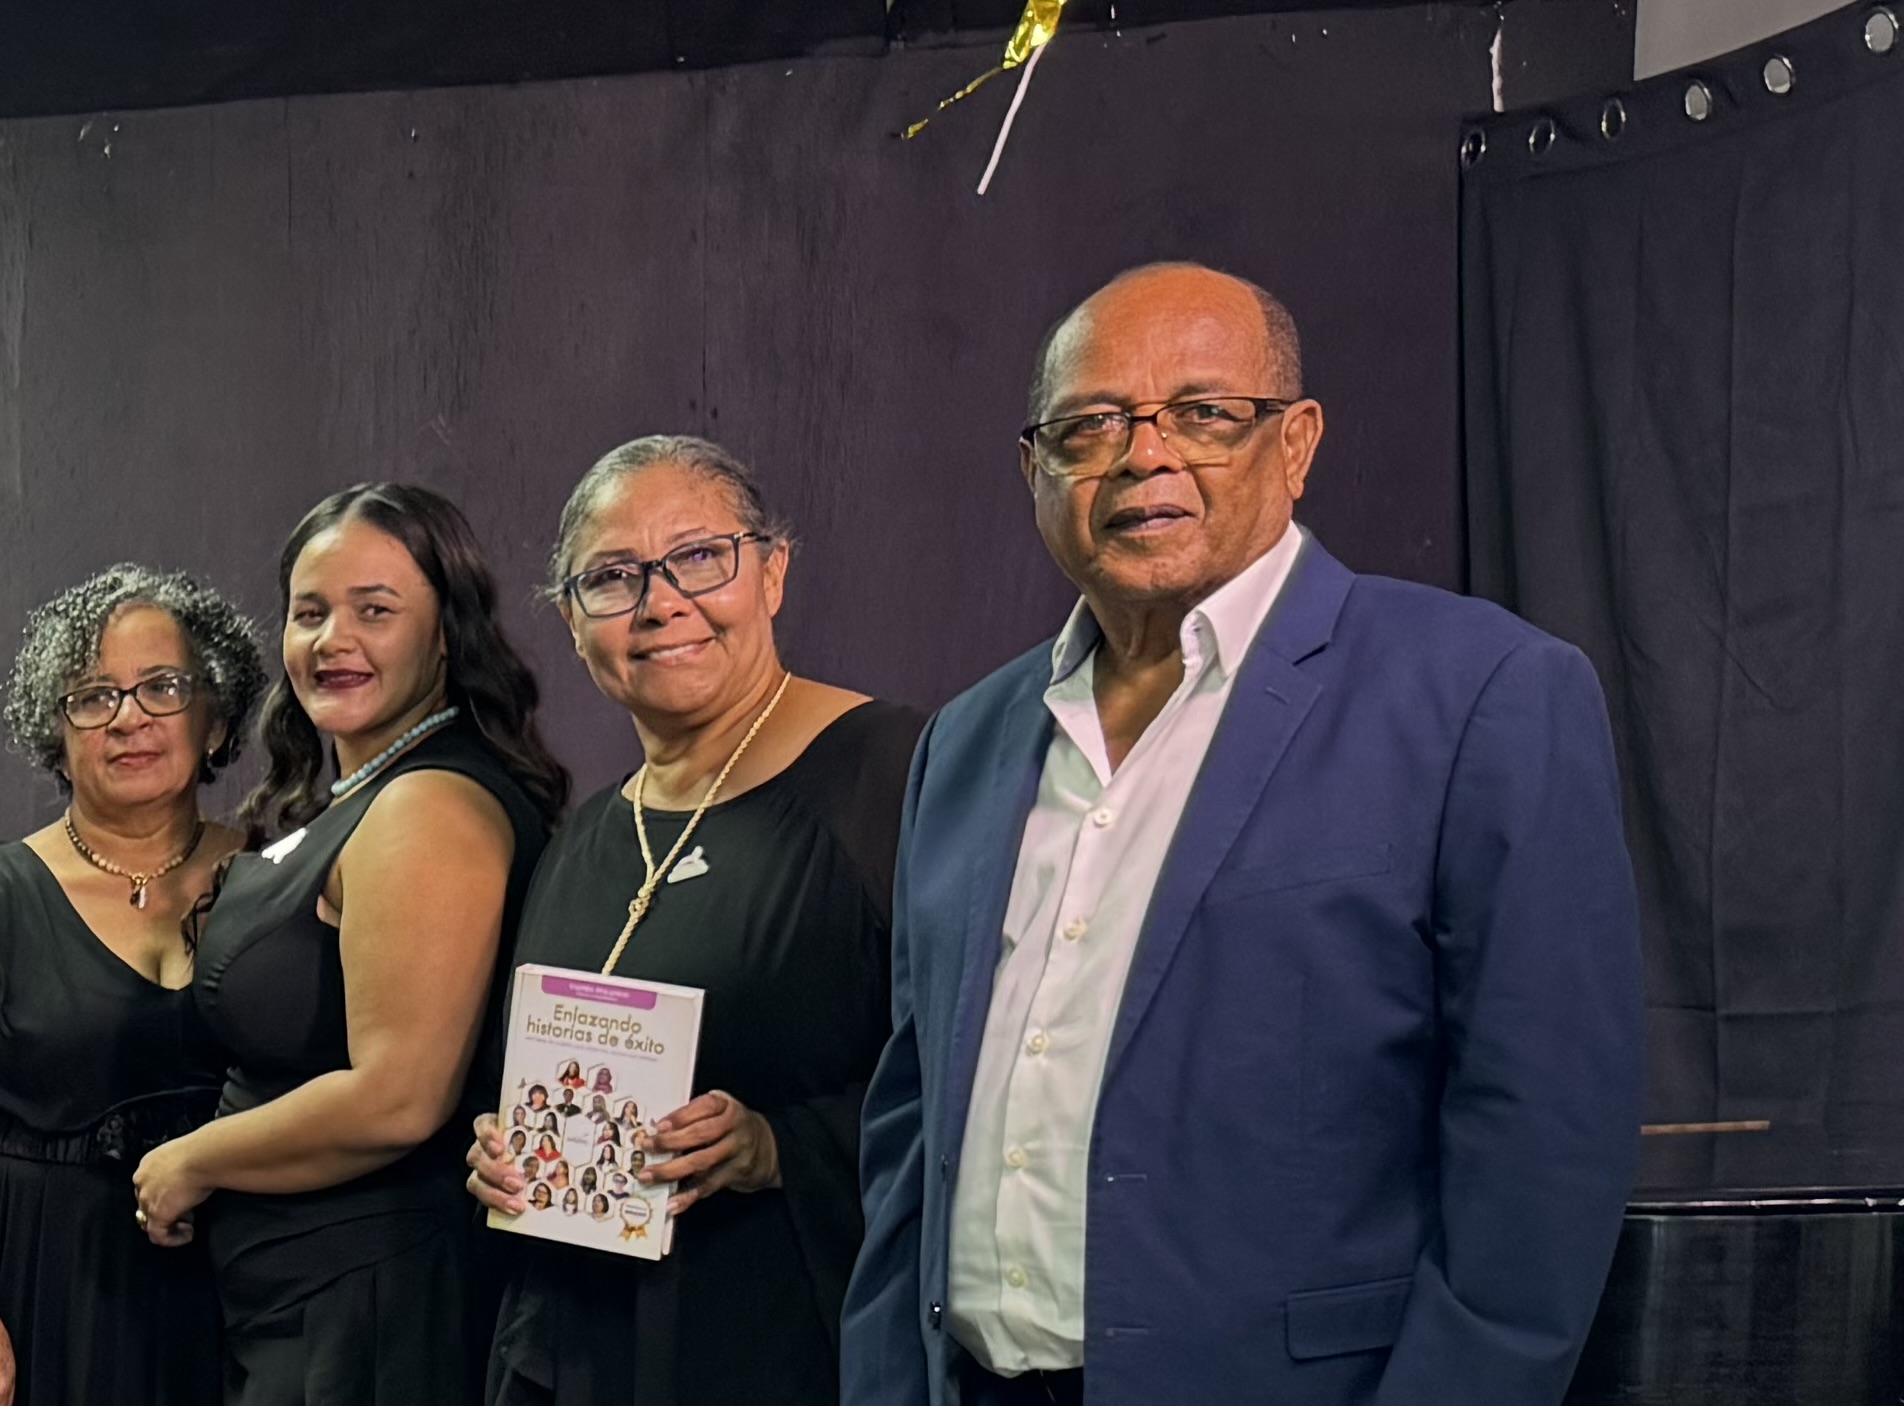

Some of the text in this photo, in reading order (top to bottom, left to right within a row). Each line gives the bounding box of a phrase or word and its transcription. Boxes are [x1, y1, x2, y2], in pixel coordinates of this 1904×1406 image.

[527, 1014, 593, 1043] historias
[624, 1033, 665, 1055] éxito
[553, 1004, 642, 1034] Enlazando
